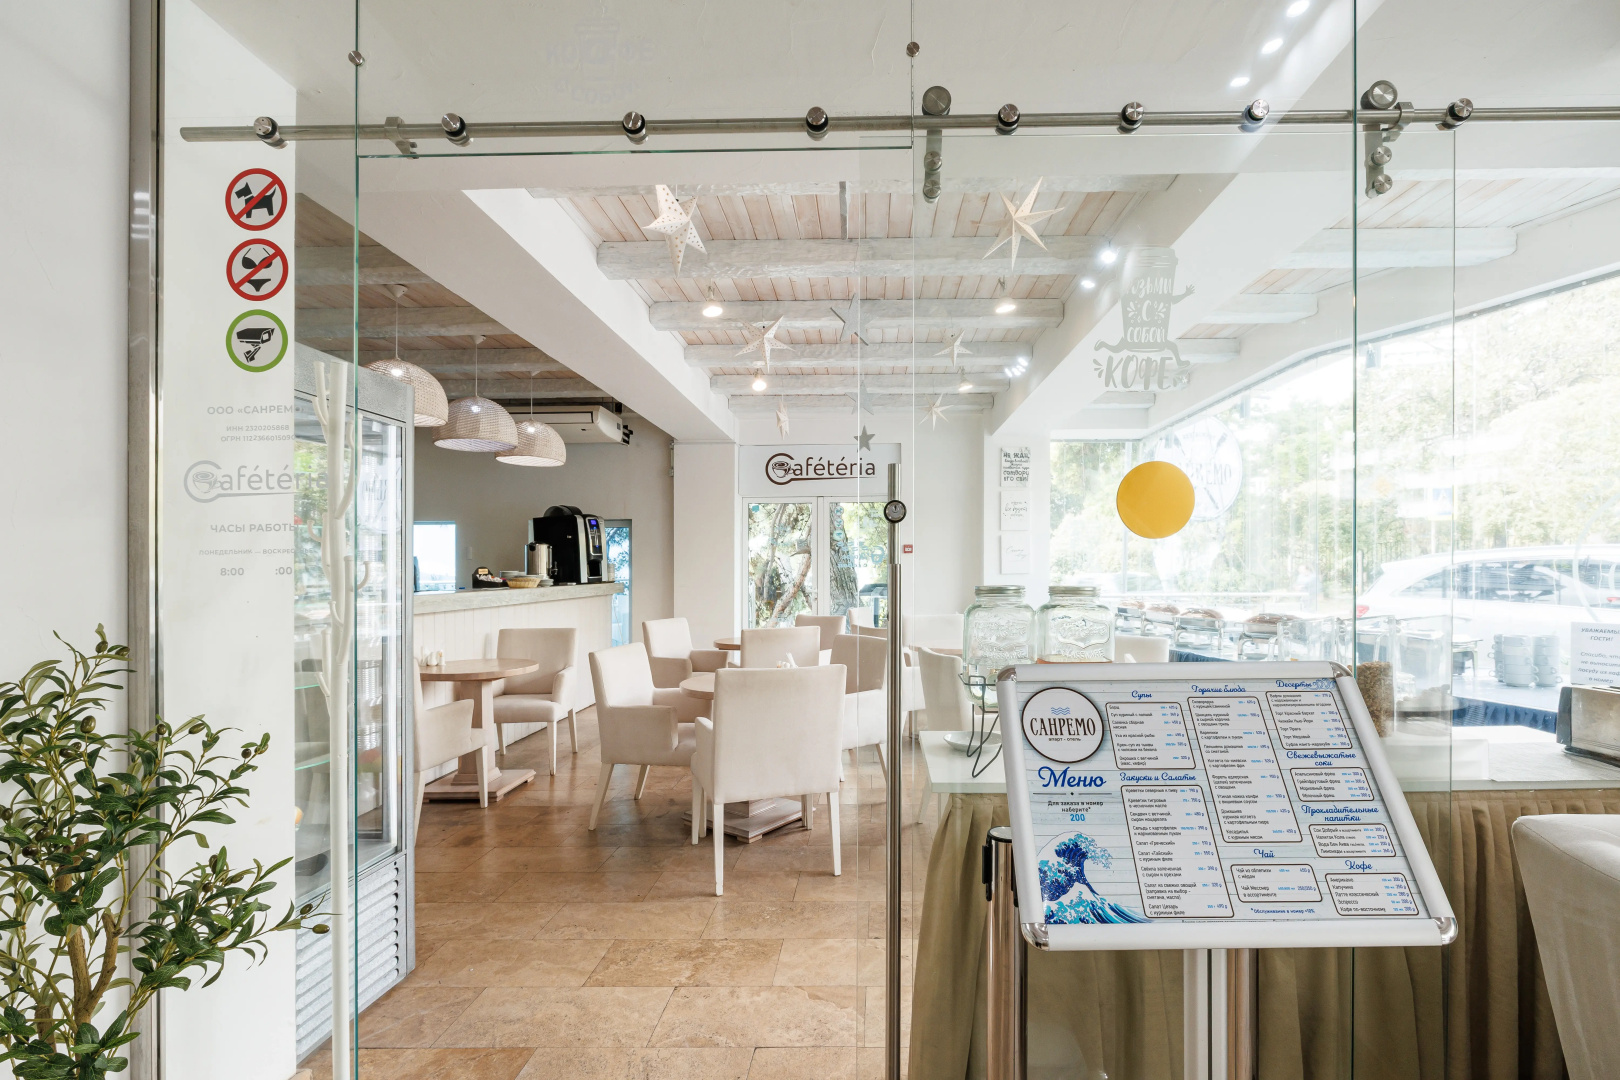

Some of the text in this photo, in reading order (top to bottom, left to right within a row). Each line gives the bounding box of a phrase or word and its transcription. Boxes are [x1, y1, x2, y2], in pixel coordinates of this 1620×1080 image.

[1141, 300, 1152, 321] С
[1104, 354, 1174, 391] КОФЕ
[207, 406, 234, 415] ООО
[245, 424, 290, 432] 2320205868
[765, 452, 876, 486] Cafétéria
[210, 523, 299, 533] ЧАСЫ РАБОТЫ
[220, 567, 245, 576] 8:00
[1275, 679, 1313, 690] Десерты
[1131, 690, 1153, 700] Супы
[1030, 717, 1096, 736] САНРЕМО
[1286, 750, 1357, 759] Свежевыжатые
[1038, 766, 1107, 788] Меню
[1120, 771, 1153, 783] Закуски
[1161, 772, 1197, 781] Салаты
[1301, 804, 1379, 816] Прохладительные
[1070, 814, 1086, 822] 200
[1324, 814, 1362, 822] напитки
[1253, 848, 1276, 858] Чай
[1344, 859, 1373, 873] Кофе
